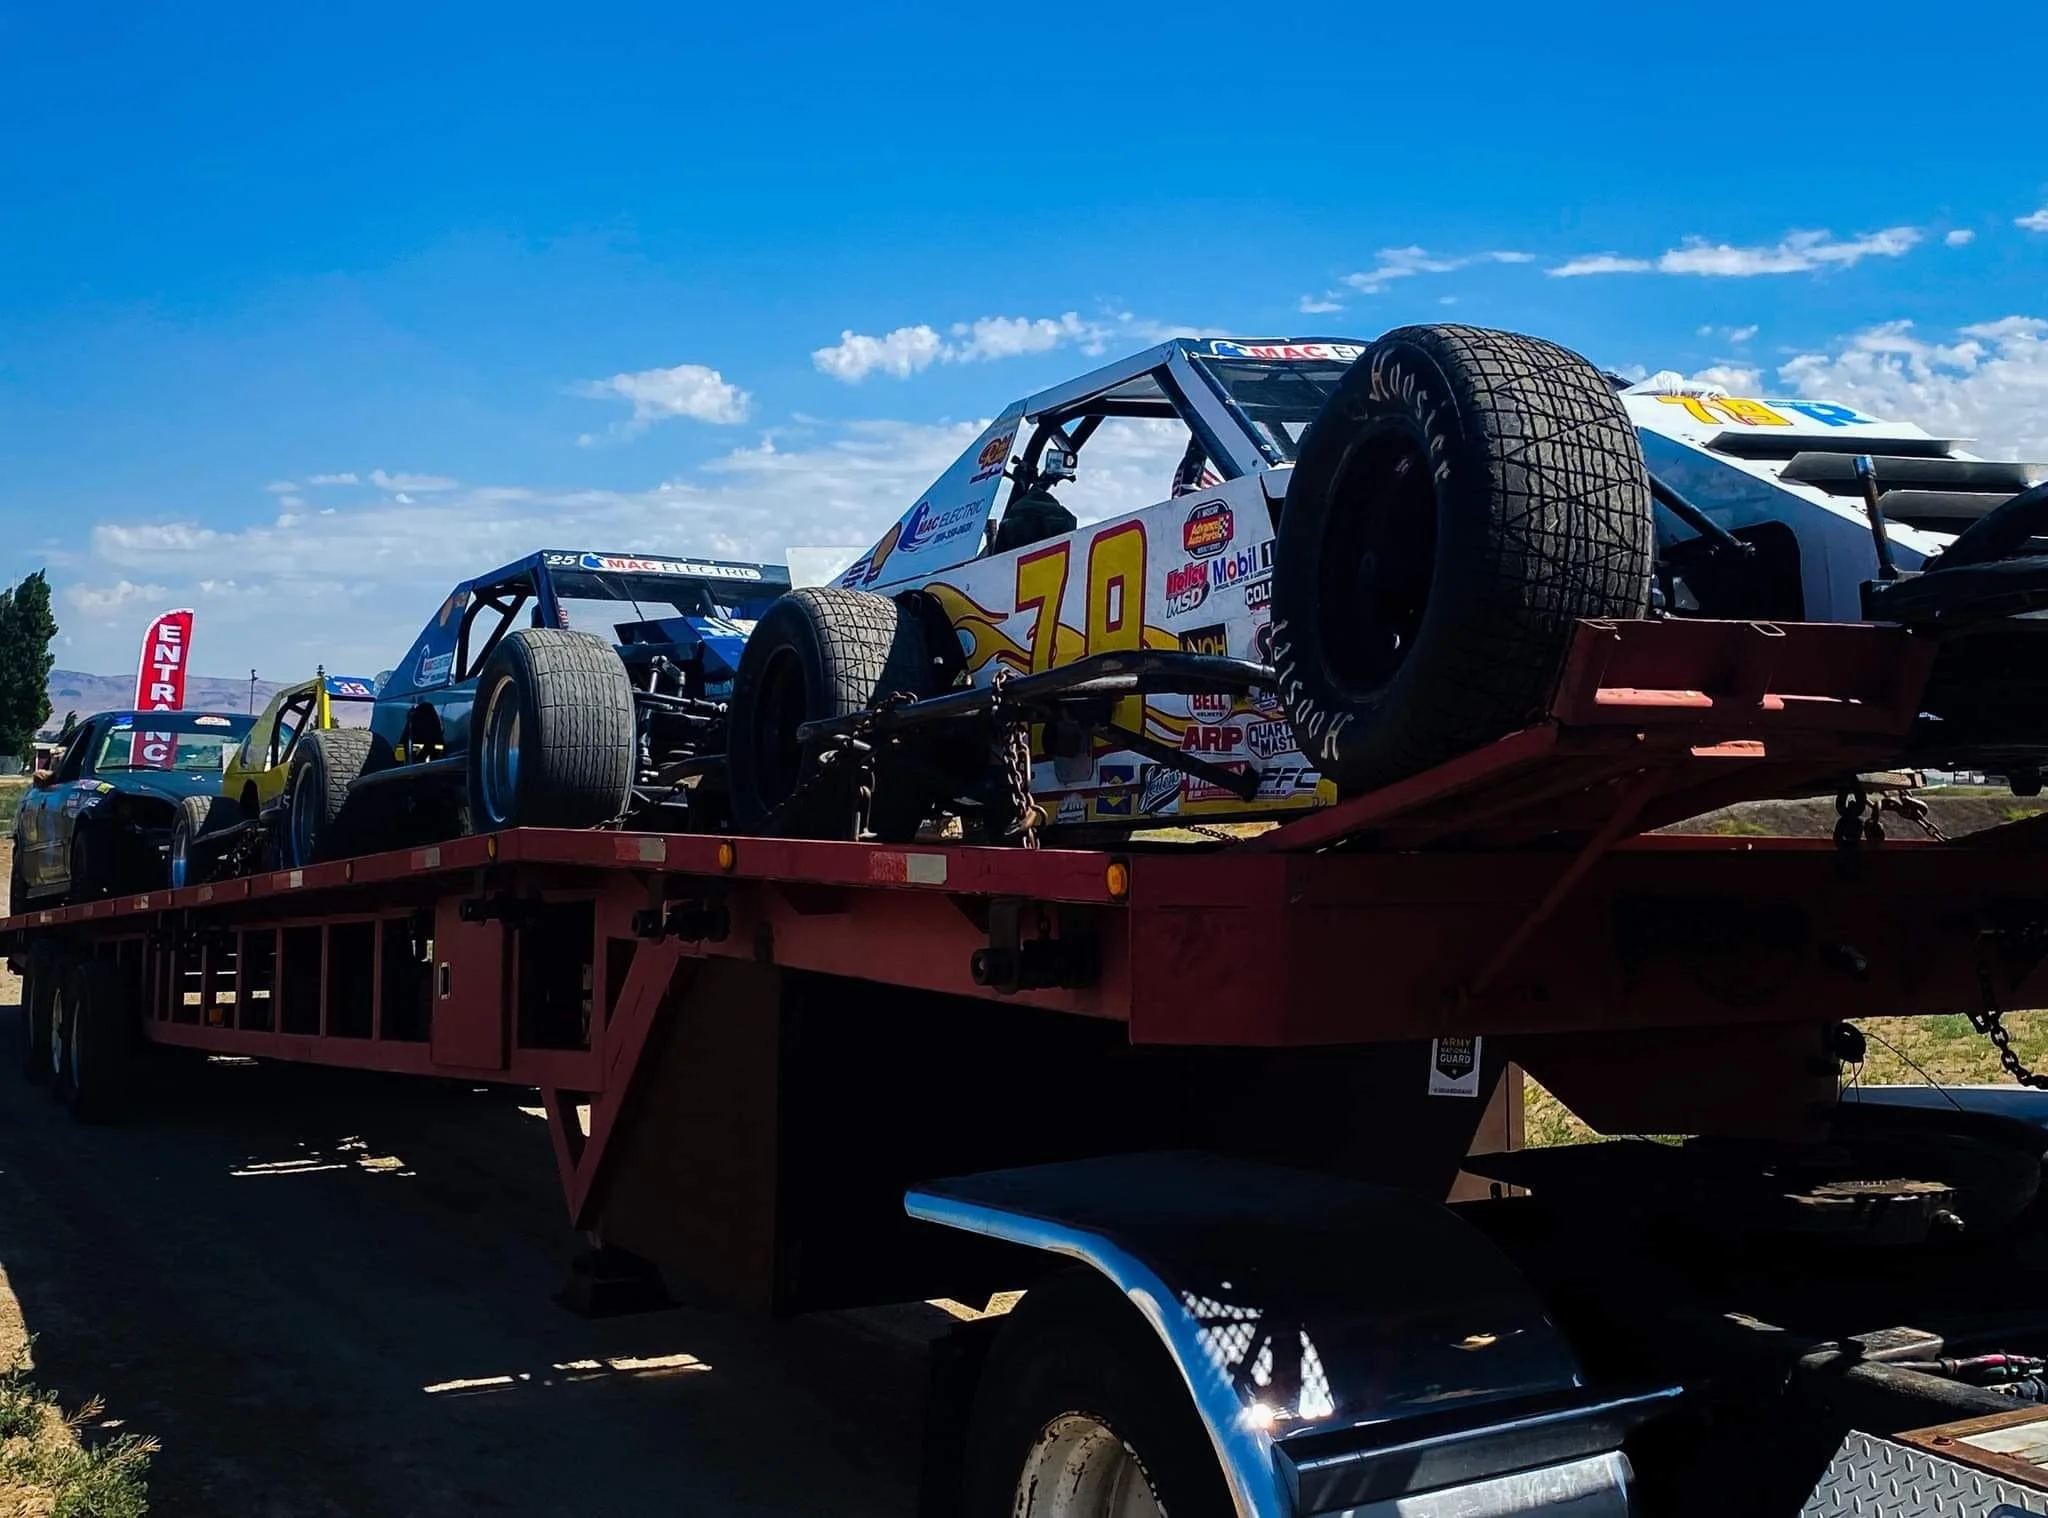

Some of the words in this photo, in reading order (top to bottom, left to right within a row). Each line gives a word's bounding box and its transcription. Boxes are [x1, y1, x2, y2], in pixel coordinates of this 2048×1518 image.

[1250, 346, 1328, 360] MAC
[917, 515, 940, 536] MAC
[939, 498, 986, 528] ELECTRIC
[547, 554, 577, 566] 25
[607, 558, 657, 571] MAC
[662, 562, 758, 578] ELECTRIC
[1212, 545, 1257, 586] Mobil
[1166, 587, 1206, 619] MSD
[1193, 694, 1225, 710] BELL
[1181, 726, 1243, 751] ARP
[1441, 1037, 1471, 1047] ARMY
[1440, 1053, 1471, 1064] GUARD
